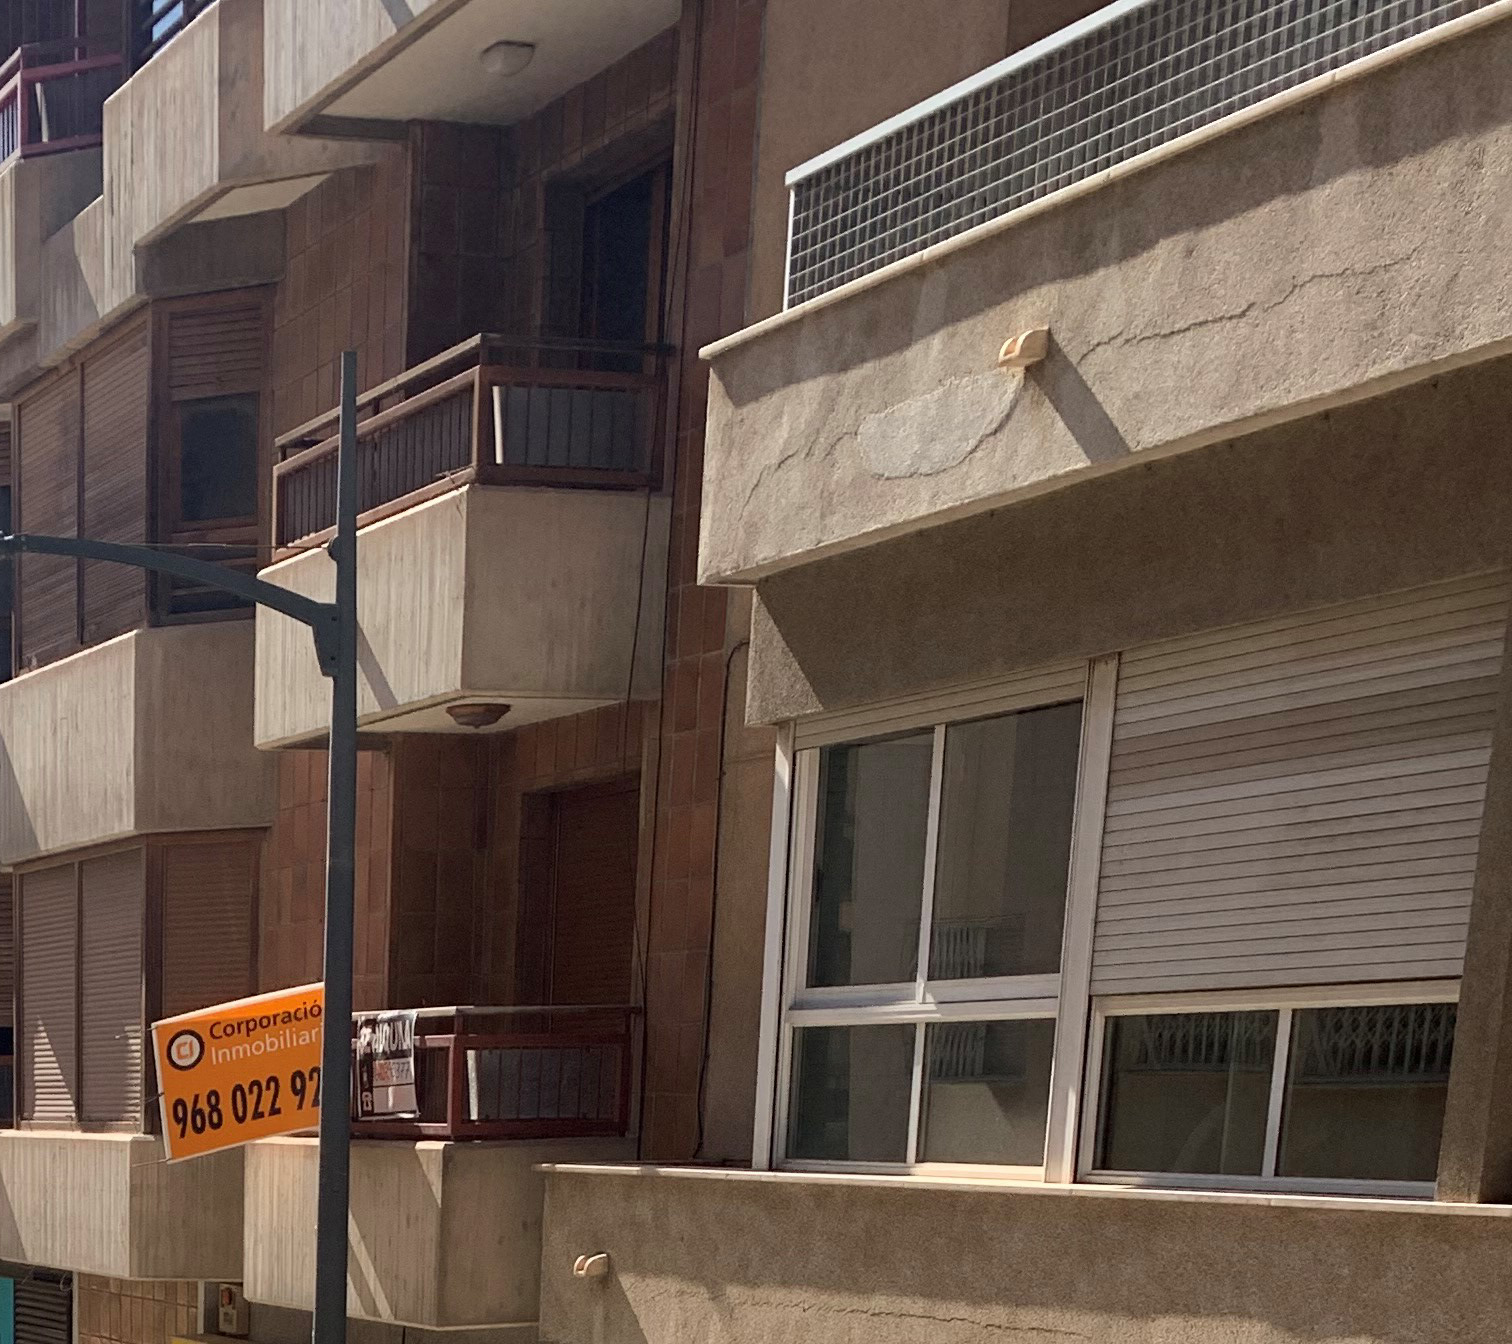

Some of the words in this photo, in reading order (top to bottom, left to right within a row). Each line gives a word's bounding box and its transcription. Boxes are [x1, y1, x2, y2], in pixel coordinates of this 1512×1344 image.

[209, 1000, 322, 1040] Corporació
[211, 1024, 324, 1065] Inmobiliari
[172, 1089, 223, 1139] 968
[231, 1075, 281, 1124] 022
[290, 1066, 321, 1110] 92
